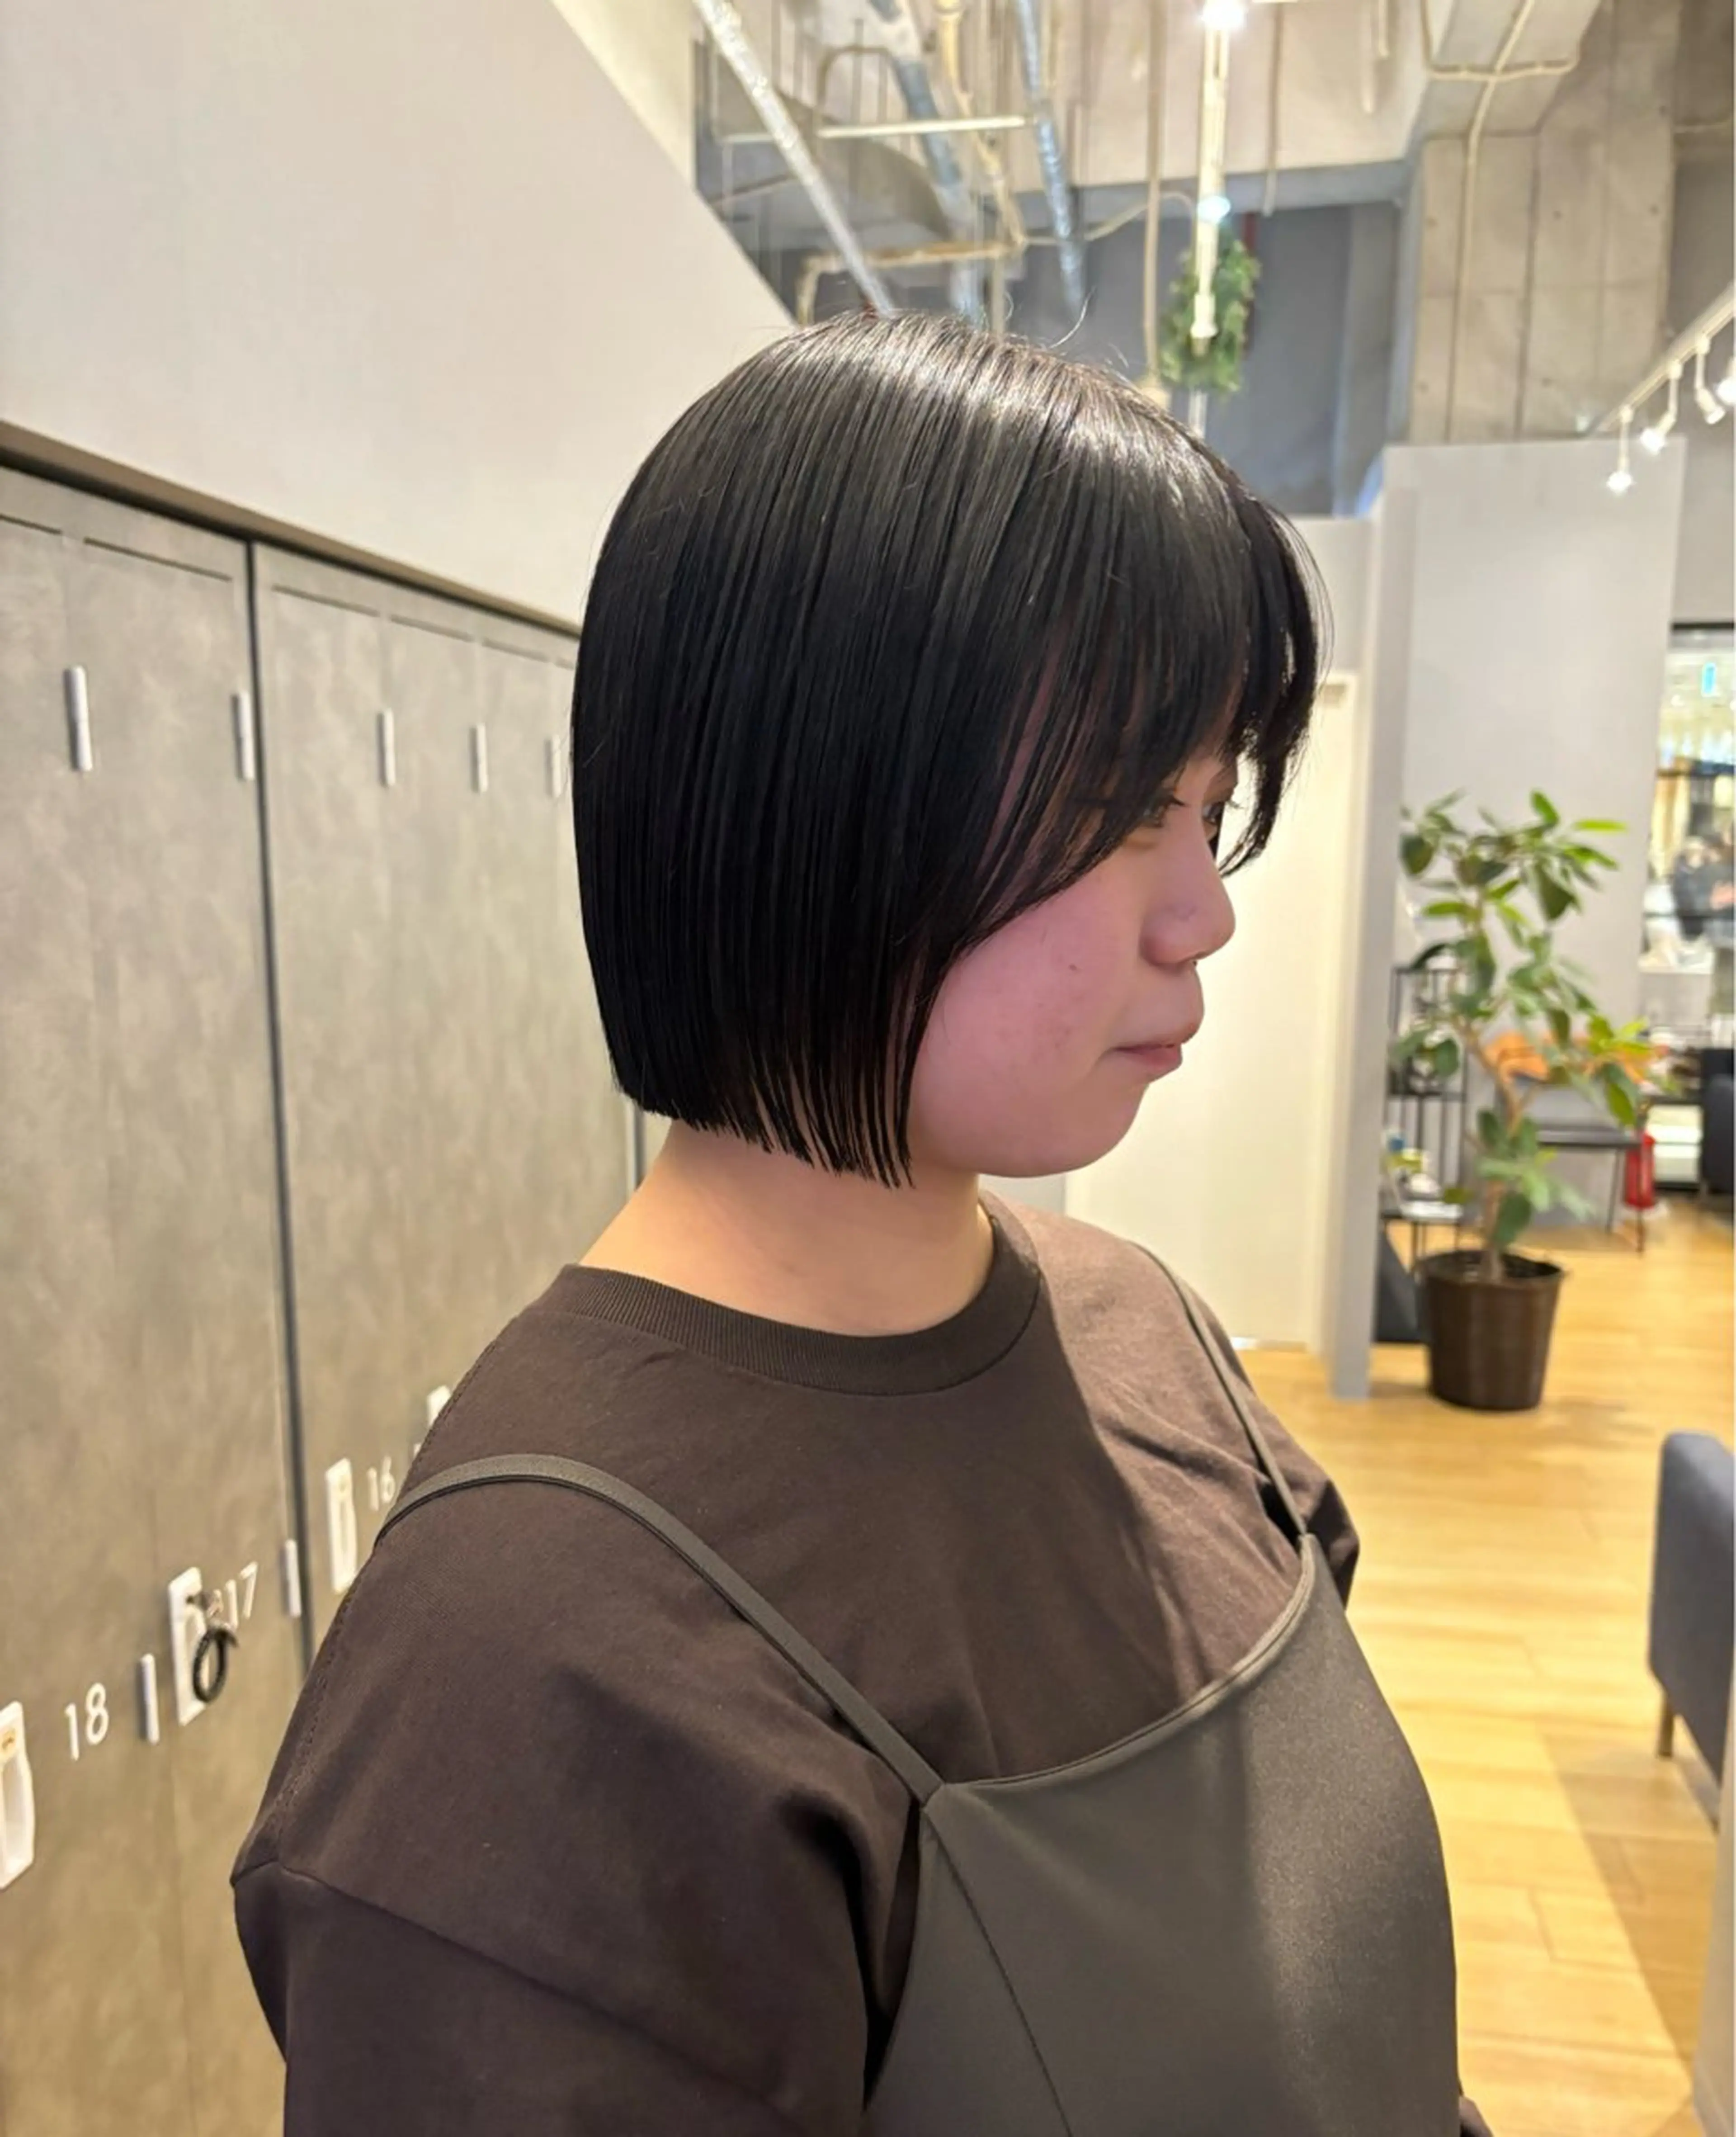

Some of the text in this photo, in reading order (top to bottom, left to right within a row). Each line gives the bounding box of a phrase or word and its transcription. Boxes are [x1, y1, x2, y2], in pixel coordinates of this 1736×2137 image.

[367, 1456, 396, 1511] 16
[225, 1561, 258, 1629] 17
[65, 1682, 109, 1761] 18
